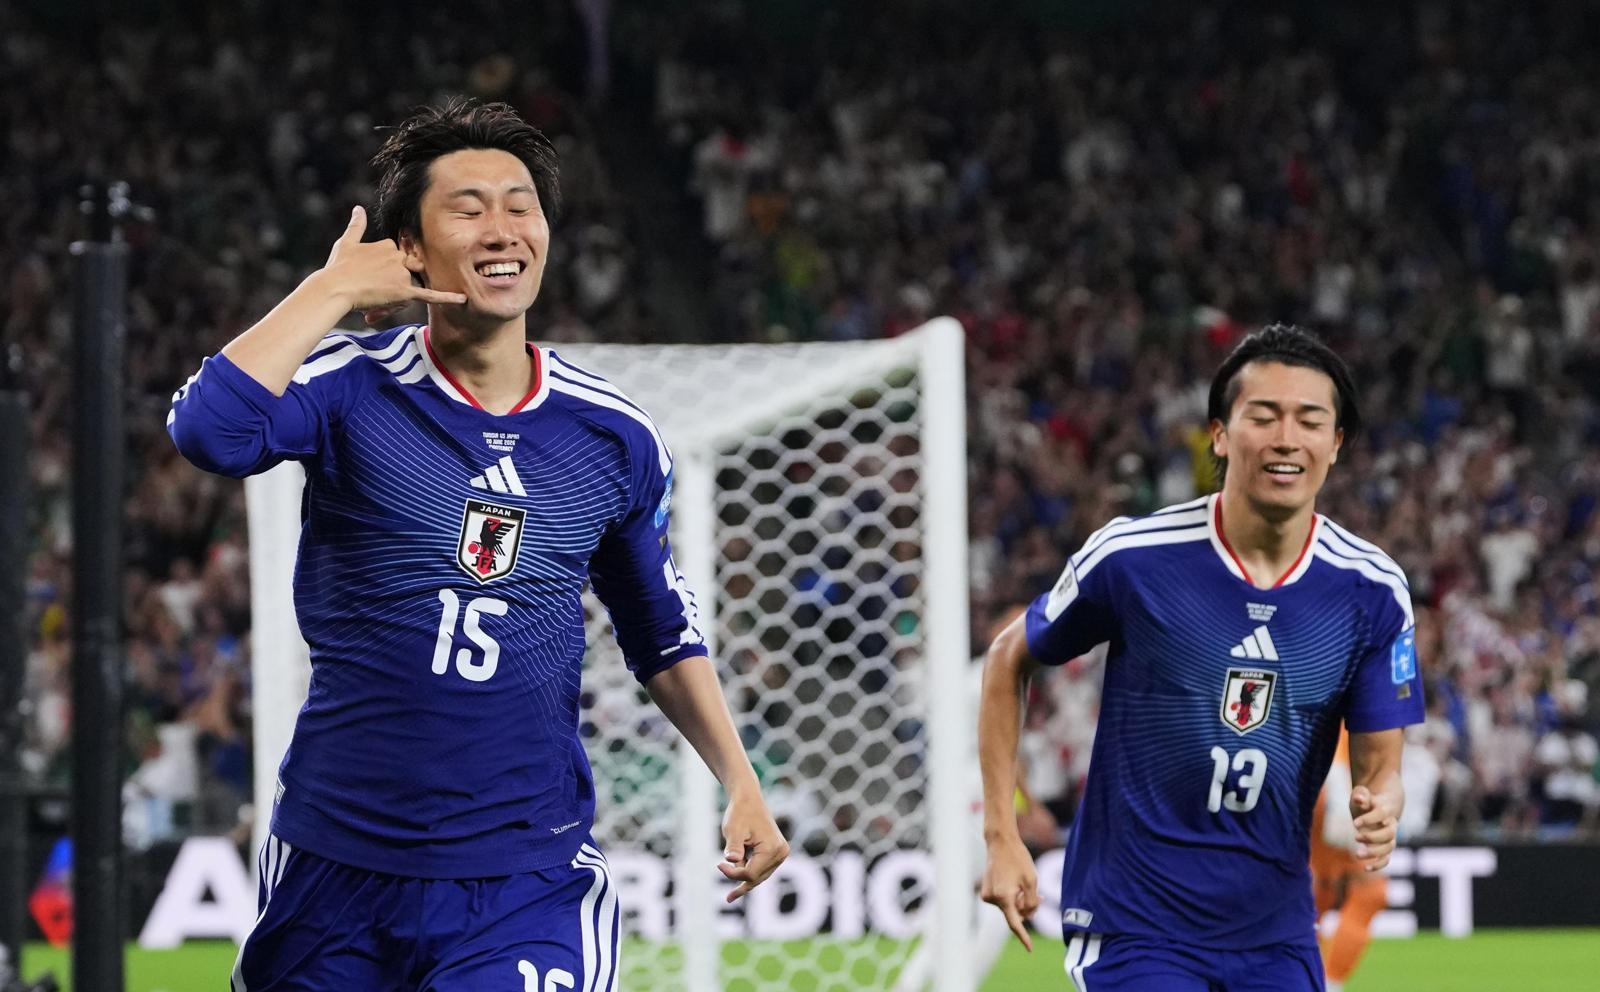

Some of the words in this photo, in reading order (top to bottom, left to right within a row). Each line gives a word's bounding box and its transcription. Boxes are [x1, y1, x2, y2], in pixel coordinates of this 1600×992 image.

[480, 505, 511, 517] JAPAN
[471, 555, 497, 571] JFA
[431, 588, 509, 682] 15
[1207, 745, 1268, 813] 13
